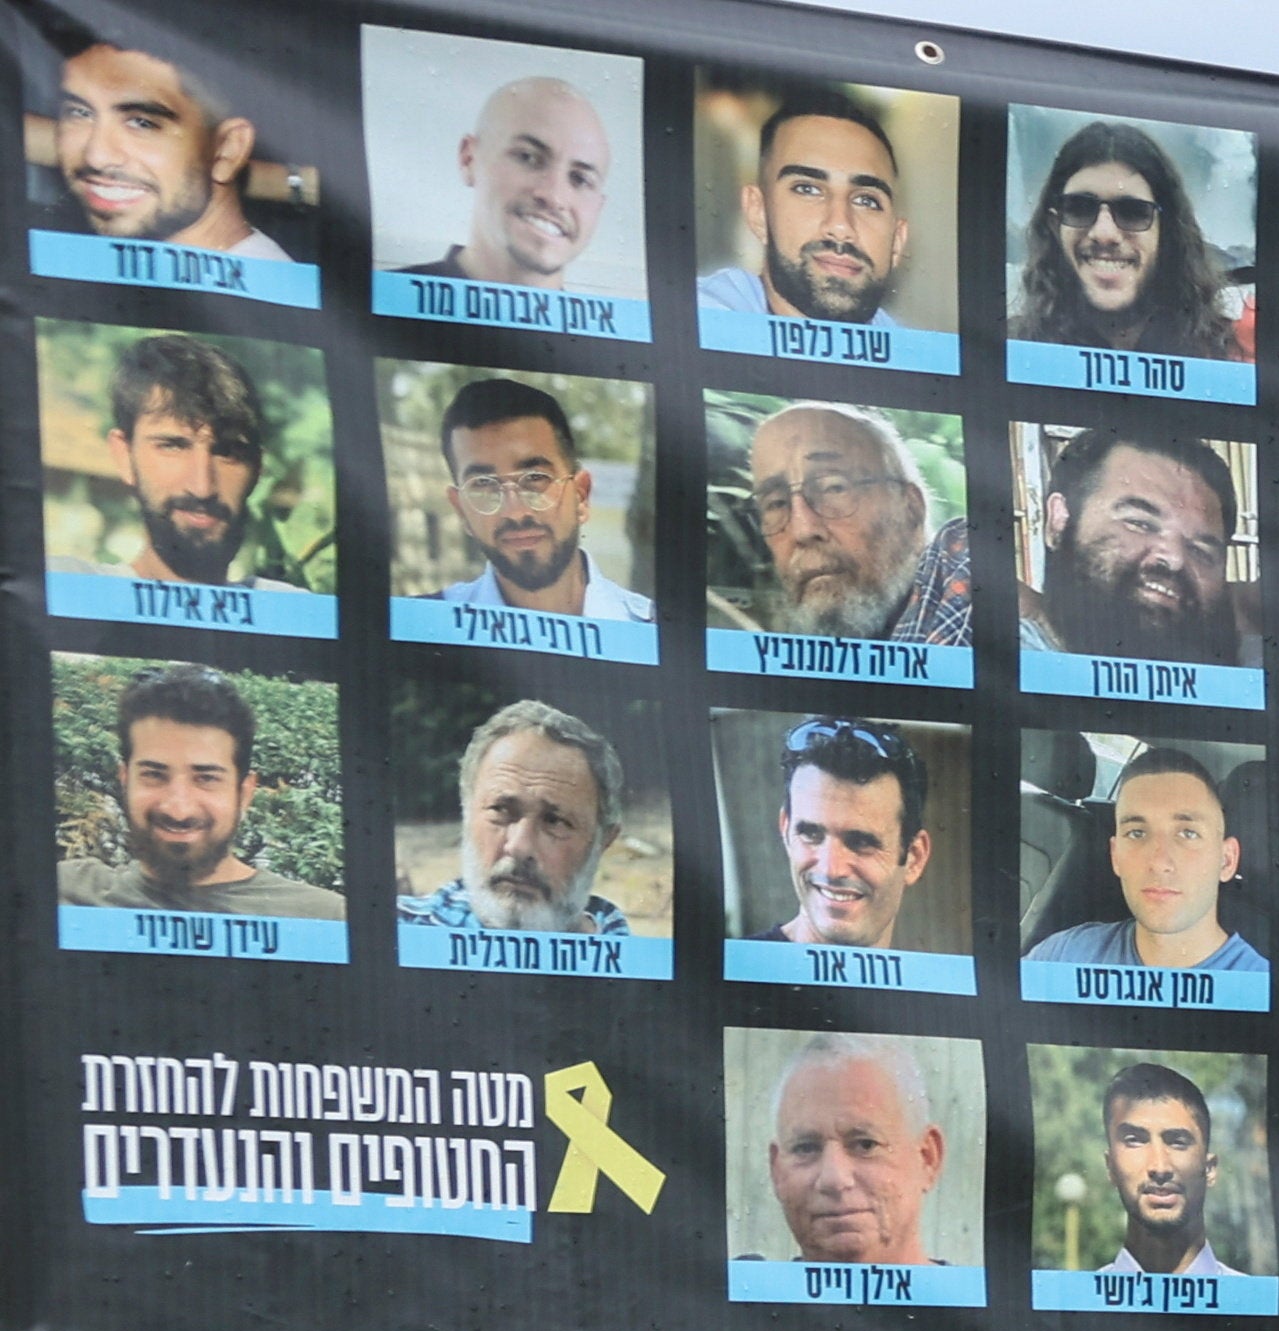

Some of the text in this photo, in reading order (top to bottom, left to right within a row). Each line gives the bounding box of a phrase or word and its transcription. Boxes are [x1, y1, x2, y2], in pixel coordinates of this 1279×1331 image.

[111, 241, 249, 290] אביתר דוד
[410, 279, 615, 333] איתן אברהם מור
[768, 319, 890, 364] שגב כלפון
[1079, 350, 1185, 392] סהר ברוך
[132, 582, 253, 625] גיא אילוז
[453, 604, 601, 657] רן רני גואילי
[753, 635, 929, 680] אריה זלמנוביץ
[1091, 660, 1197, 701] איתן הורן
[136, 914, 278, 957] עידן שתיוי
[450, 930, 622, 974] אליהו מרגלית
[806, 949, 902, 987] דרור אור
[1075, 967, 1215, 1008] מתן אנגרסט
[80, 1051, 534, 1129] מטה המשפחות להחזרת
[83, 1123, 538, 1212] החטופים והנעדרים
[804, 1266, 912, 1304] אילן וייס
[1162, 1277, 1219, 1312] ביפין
